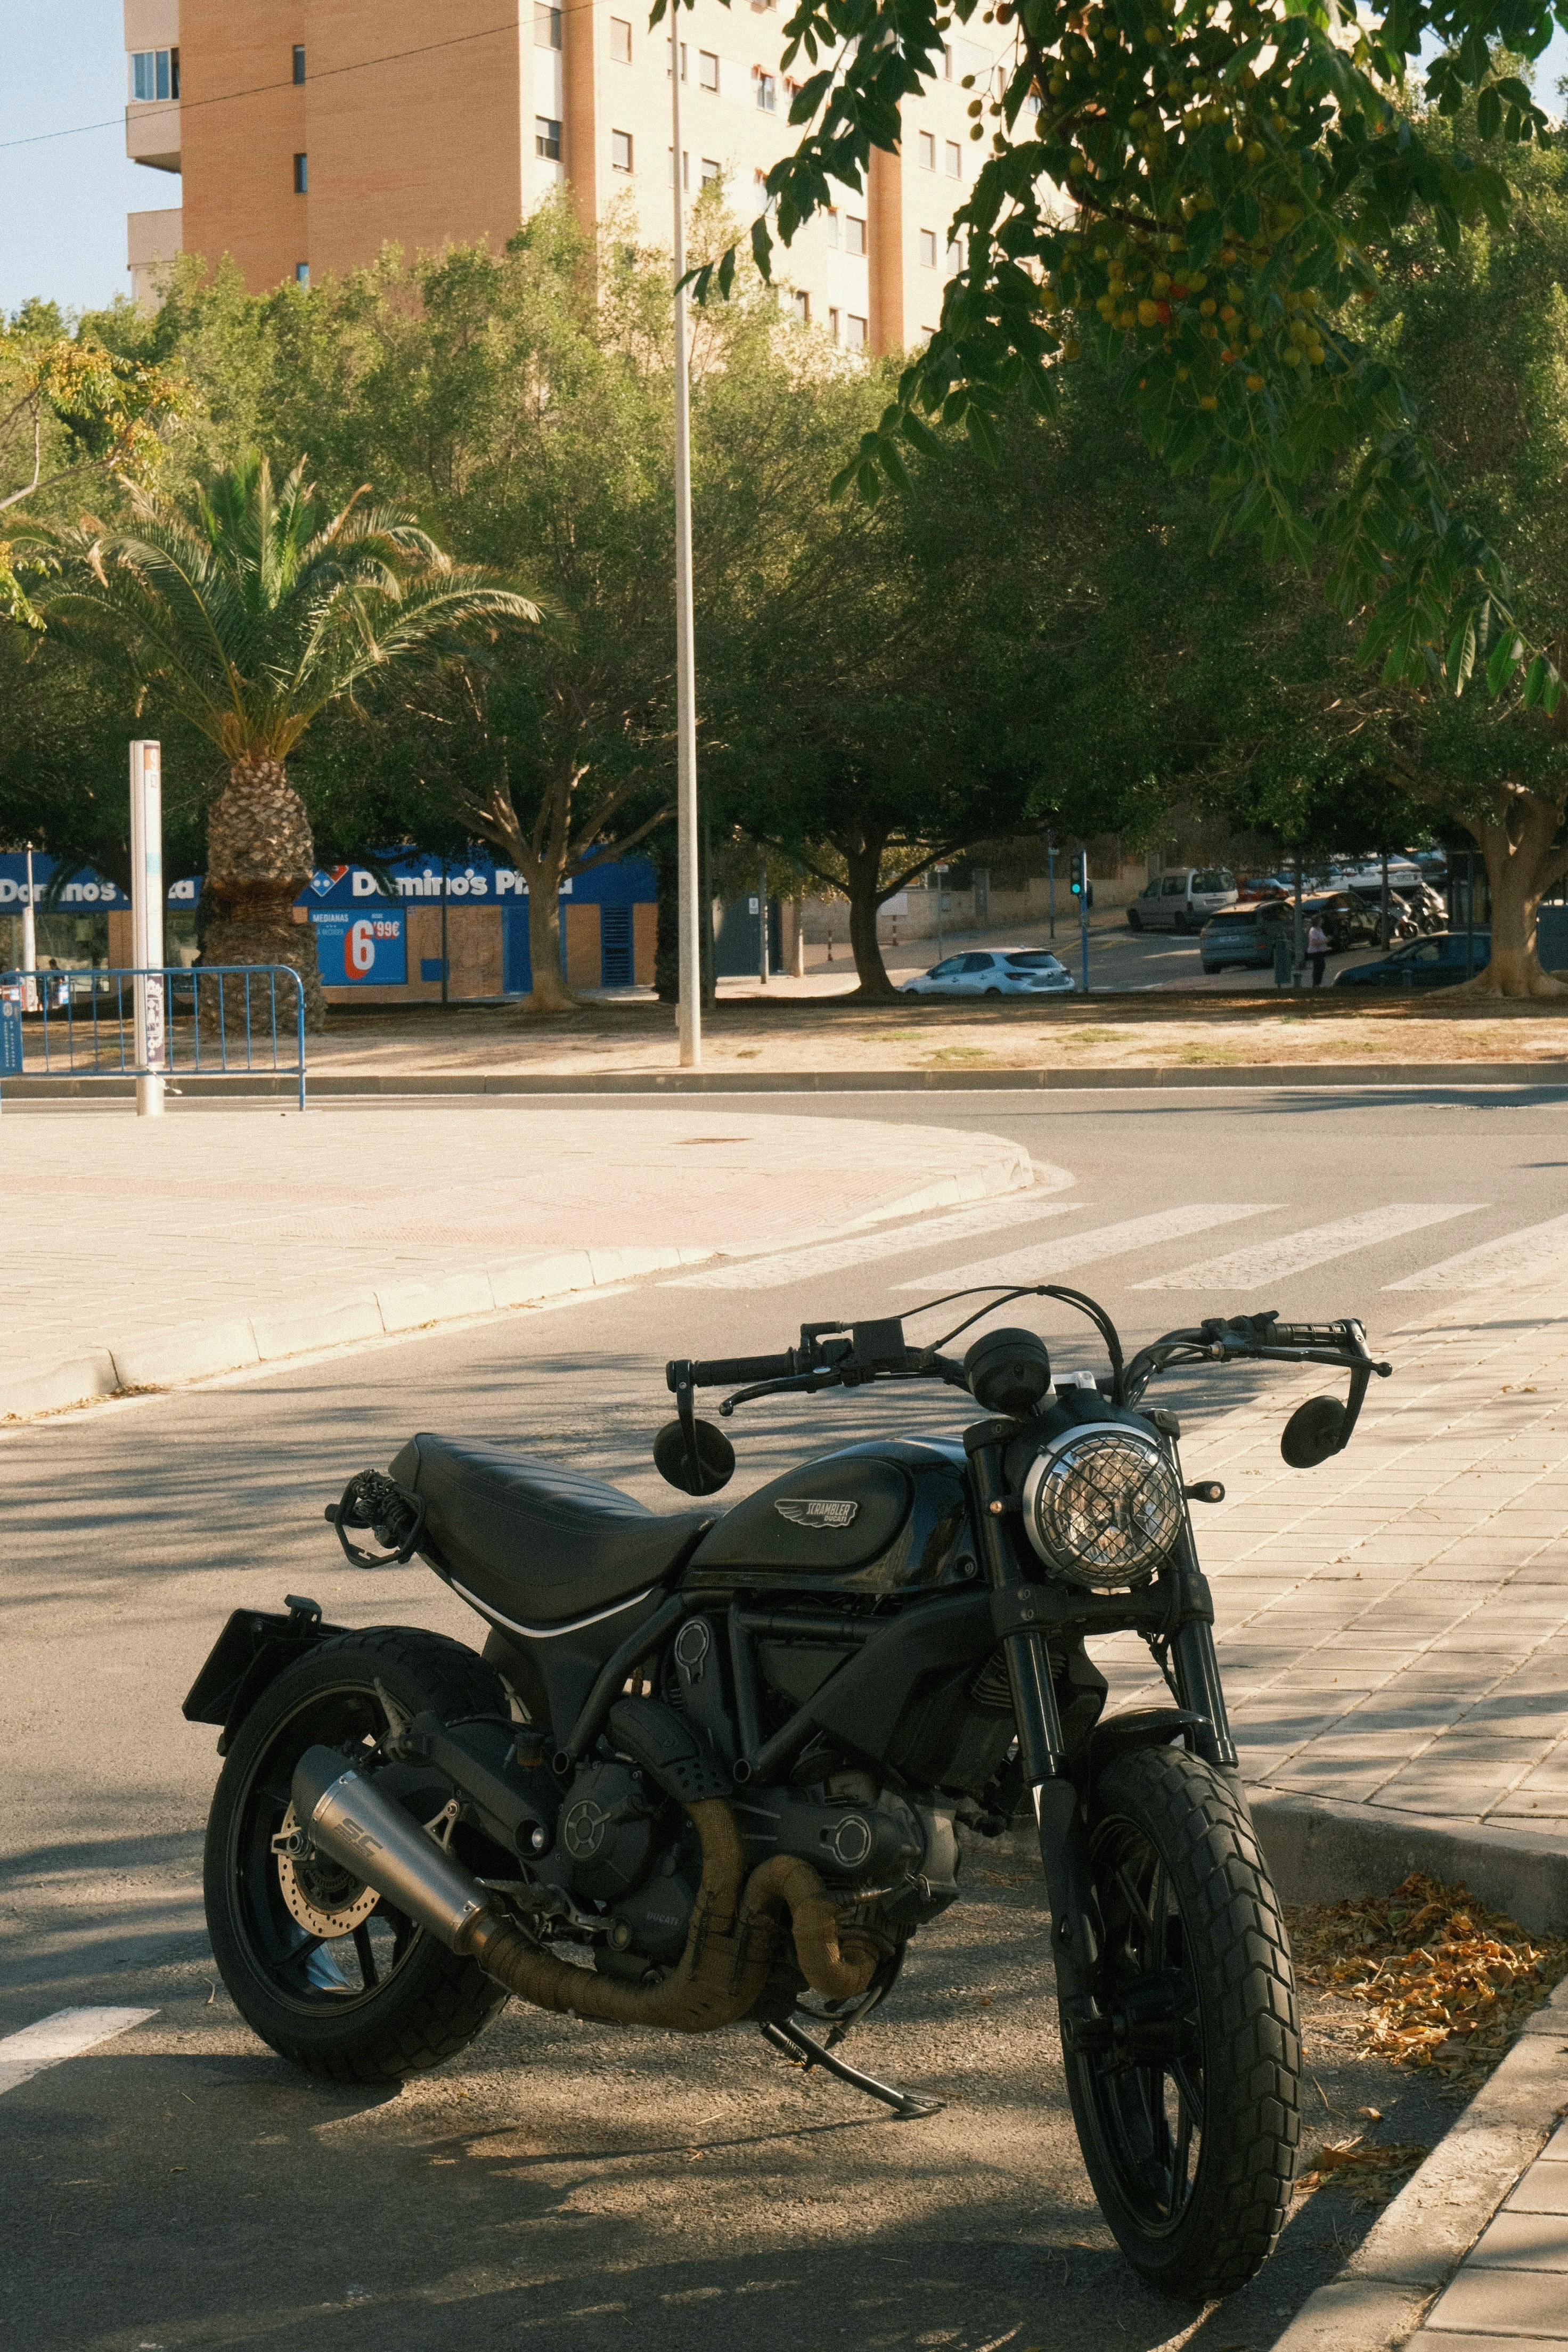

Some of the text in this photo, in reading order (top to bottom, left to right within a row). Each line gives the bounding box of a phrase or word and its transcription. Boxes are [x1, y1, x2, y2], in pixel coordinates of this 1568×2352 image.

[312, 914, 349, 922] MEDIANAS
[806, 1502, 851, 1516] SCRAMBLER
[336, 1818, 383, 1855] SC
[646, 1911, 679, 1926] DUCATI
